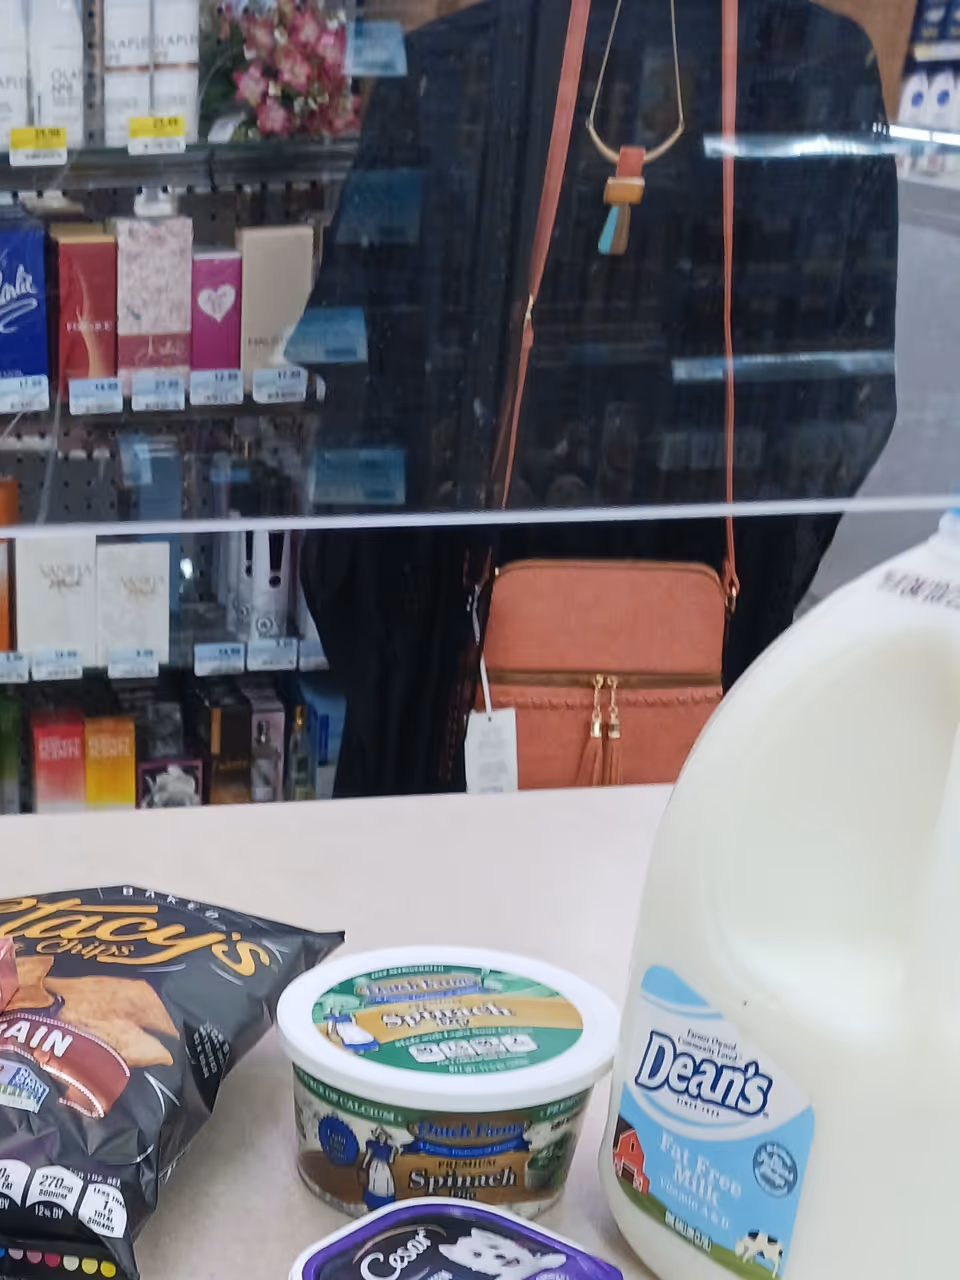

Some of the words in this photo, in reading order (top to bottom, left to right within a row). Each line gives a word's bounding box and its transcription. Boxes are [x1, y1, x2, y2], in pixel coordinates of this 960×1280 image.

[36, 937, 135, 960] Chips
[634, 1030, 773, 1117] Dean's
[340, 1097, 395, 1122] CALCIUM
[438, 1158, 497, 1169] PREMIUM
[661, 1130, 690, 1167] Fat
[693, 1154, 742, 1200] Free
[38, 1189, 68, 1200] SODIUM
[408, 1165, 517, 1196] Spinach
[674, 1162, 720, 1207] Milk
